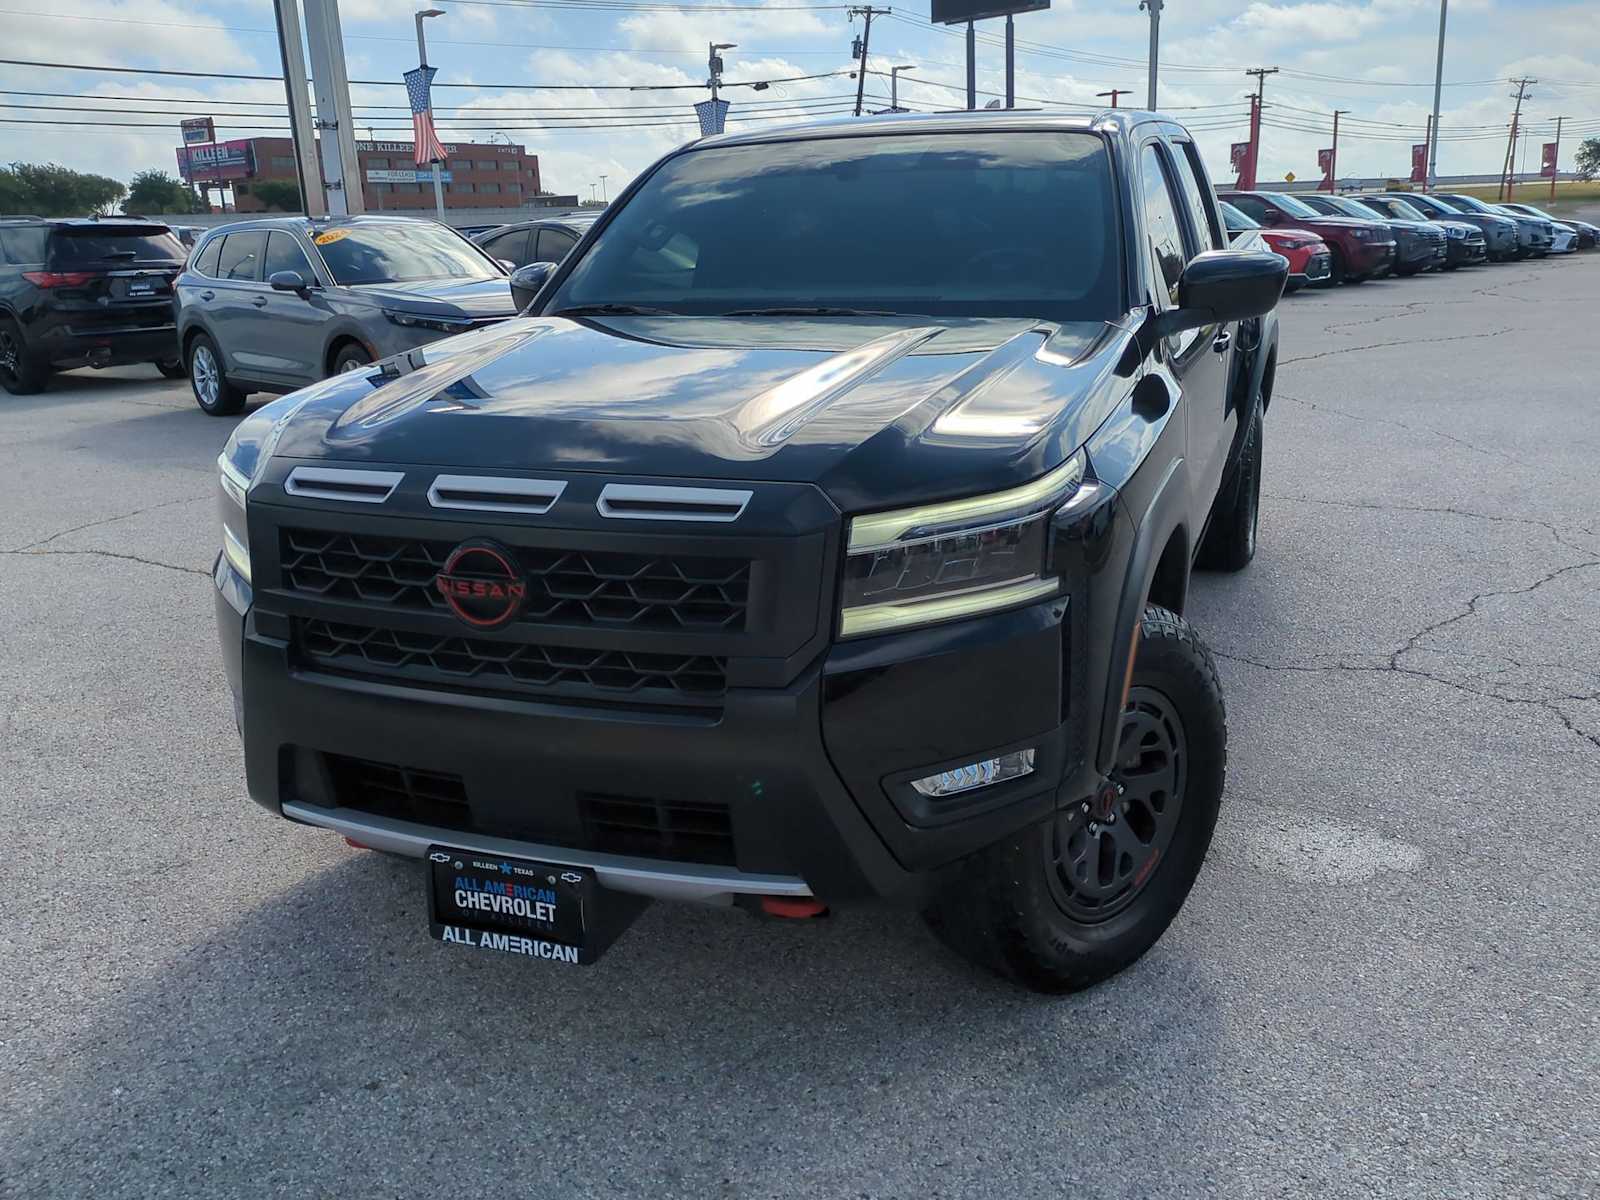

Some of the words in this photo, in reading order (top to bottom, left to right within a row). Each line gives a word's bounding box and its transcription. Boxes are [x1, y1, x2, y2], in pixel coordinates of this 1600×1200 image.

[436, 576, 525, 599] NISSAN
[472, 861, 498, 871] KILLEEN
[513, 867, 534, 876] TEXAS
[454, 877, 481, 892] ALL
[484, 880, 556, 904] AMERICAN
[454, 889, 557, 923] CHEVROLET
[442, 925, 476, 946] ALL
[479, 931, 579, 964] AMERICAN
